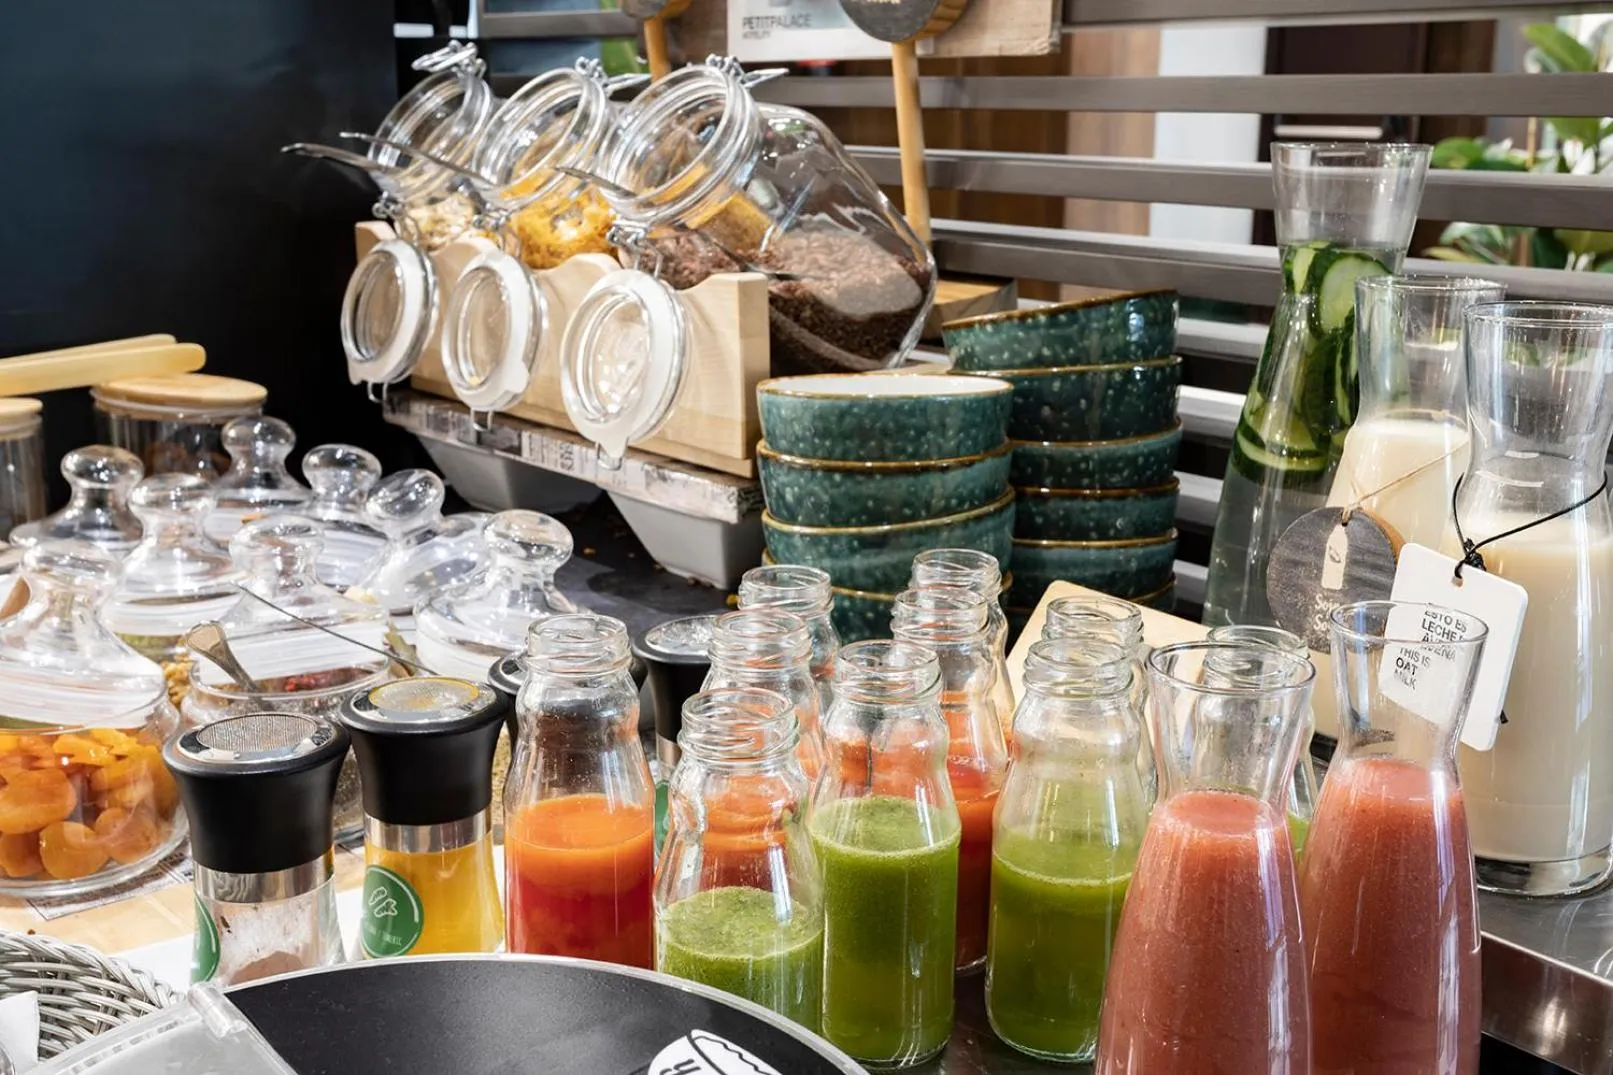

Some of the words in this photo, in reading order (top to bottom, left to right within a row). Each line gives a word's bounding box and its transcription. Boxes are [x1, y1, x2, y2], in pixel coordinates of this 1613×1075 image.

[742, 13, 812, 29] PETITPALACE
[1421, 619, 1457, 641] LECHE
[1424, 610, 1453, 625] ESTO
[1455, 619, 1467, 633] ES
[1395, 657, 1418, 676] OAT
[1400, 647, 1421, 664] THIS
[1421, 656, 1431, 667] IS
[1394, 670, 1416, 690] MILK
